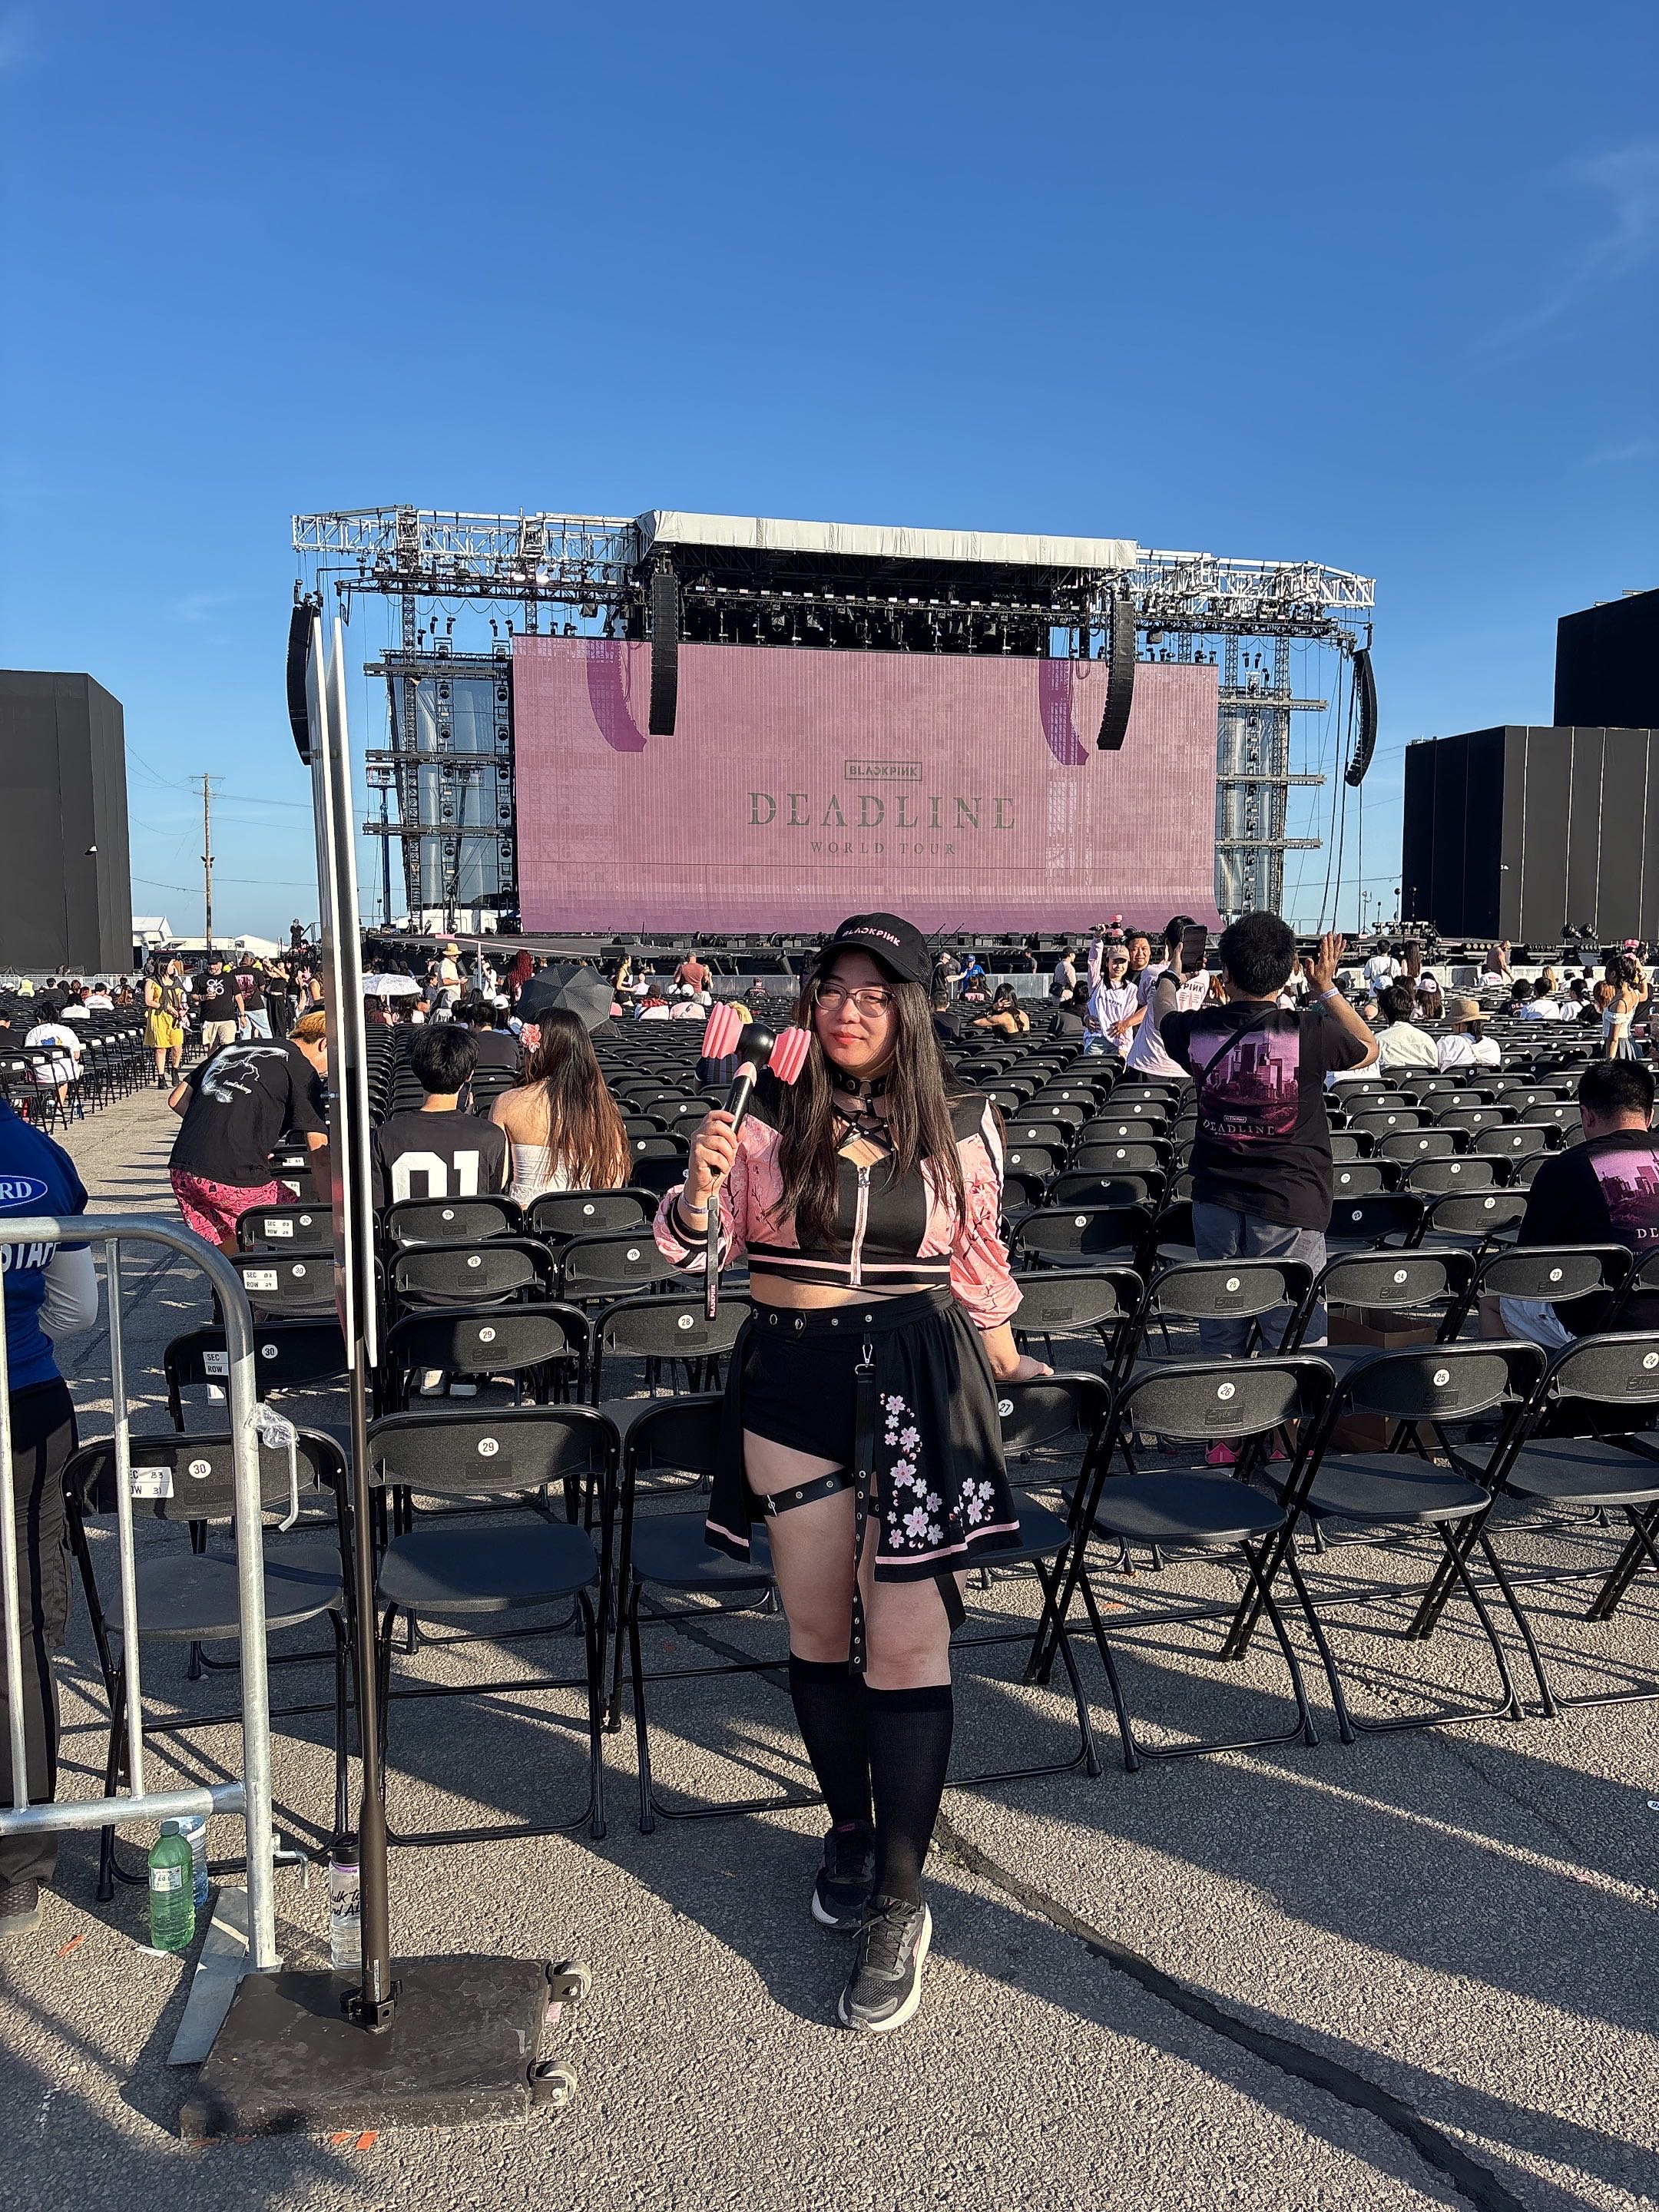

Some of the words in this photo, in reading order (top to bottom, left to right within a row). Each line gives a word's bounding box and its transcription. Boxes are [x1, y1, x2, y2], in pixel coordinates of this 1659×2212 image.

[747, 792, 1015, 830] DEADLINE
[810, 841, 885, 854] WORLD
[899, 843, 956, 855] TOUR
[1181, 982, 1204, 992] PINK
[1203, 1119, 1275, 1135] DEADLINE
[392, 1150, 480, 1204] 01
[296, 1266, 303, 1274] 30
[681, 1318, 690, 1326] 28
[483, 1330, 492, 1339] 29
[265, 1347, 275, 1357] 30
[207, 1353, 220, 1362] SEC
[1645, 1356, 1657, 1366] 24
[207, 1365, 223, 1373] ROW
[1436, 1373, 1446, 1382] 25
[1220, 1386, 1232, 1396] 26
[998, 1402, 1011, 1413] 27
[482, 1442, 495, 1452] 29
[193, 1464, 207, 1475] 30
[130, 1485, 142, 1495] OW
